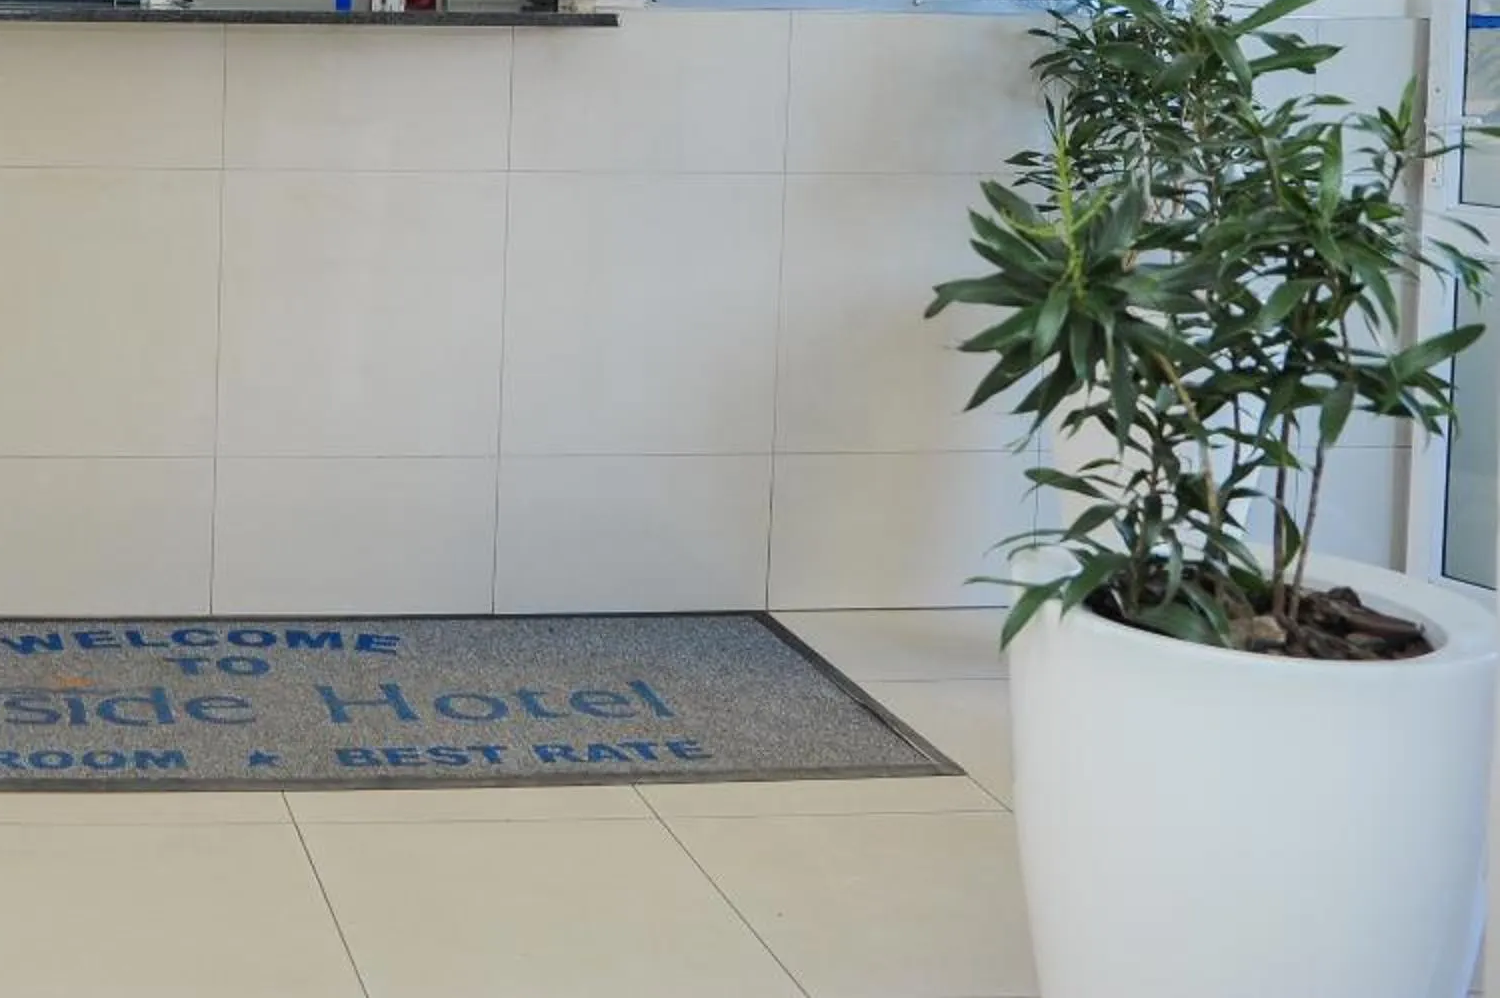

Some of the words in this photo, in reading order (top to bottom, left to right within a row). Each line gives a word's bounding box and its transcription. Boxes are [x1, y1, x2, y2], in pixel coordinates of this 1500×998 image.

[0, 627, 400, 655] WELCOME
[162, 655, 271, 676] TO
[313, 678, 677, 724] Hotel
[334, 743, 508, 767] BEST
[531, 738, 714, 765] RATE
